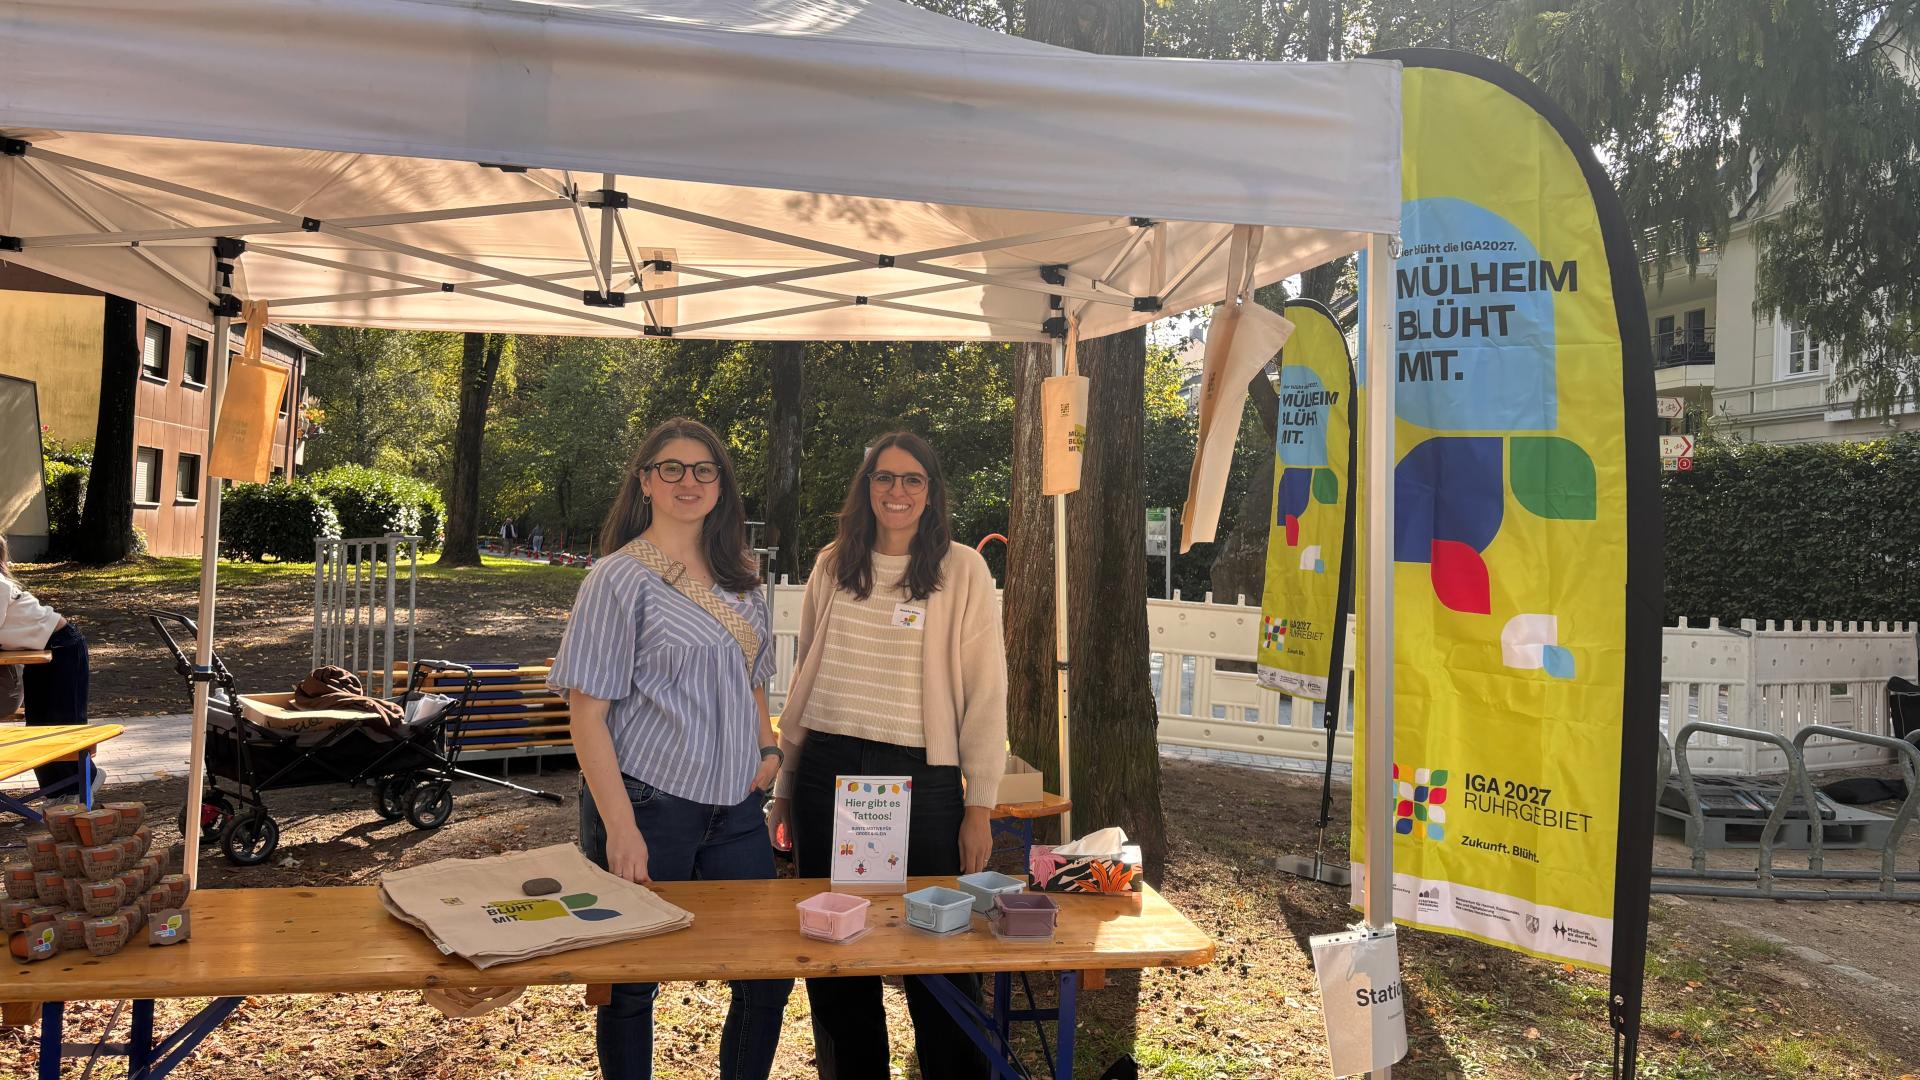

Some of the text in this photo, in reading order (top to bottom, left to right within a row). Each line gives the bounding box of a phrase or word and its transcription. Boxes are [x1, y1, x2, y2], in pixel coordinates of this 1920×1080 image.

[1400, 249, 1414, 257] ier
[1443, 242, 1459, 253] die
[1461, 240, 1518, 252] IGA2027.
[1396, 256, 1578, 299] MÜLHEIM
[1398, 299, 1516, 341] BLÜHT
[1398, 350, 1464, 383] MIT.
[845, 798, 866, 808] Hier
[867, 798, 888, 809] gibt
[1465, 773, 1552, 806] IGA 2027
[853, 811, 893, 821] Tattoos!
[1464, 792, 1593, 833] RUHRGEBIET
[1461, 835, 1540, 863] Zukunft. Blüht.
[492, 914, 523, 924] MIT.
